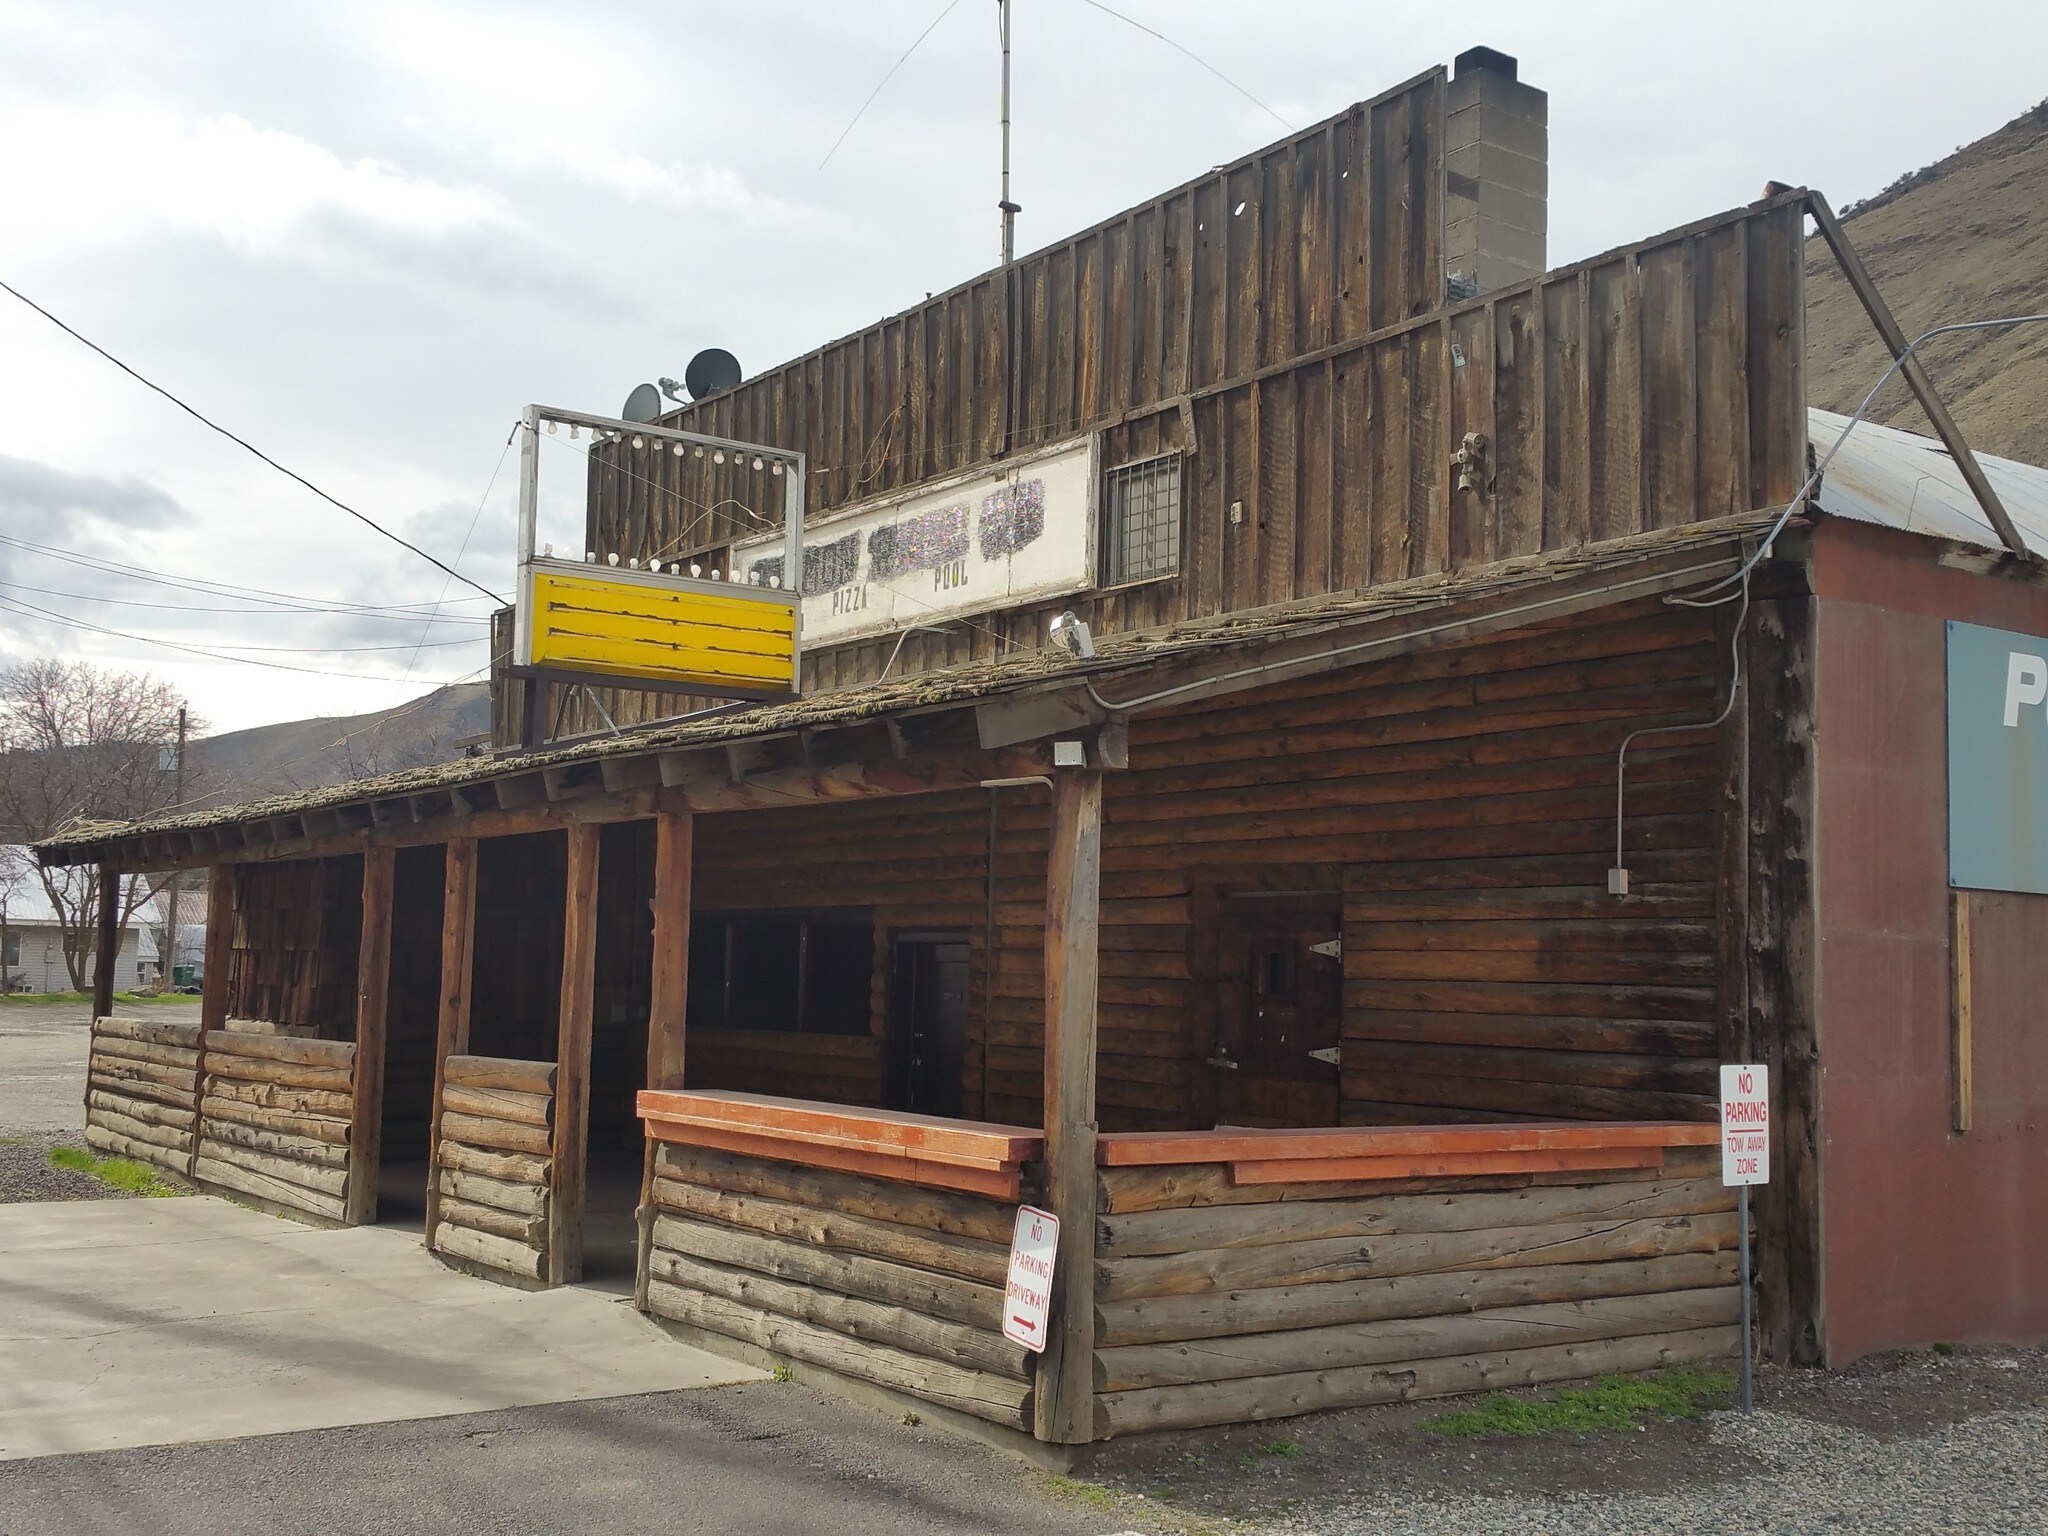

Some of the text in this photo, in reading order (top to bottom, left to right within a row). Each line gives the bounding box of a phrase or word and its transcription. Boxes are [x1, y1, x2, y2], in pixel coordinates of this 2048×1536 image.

[833, 559, 968, 616] PIZZA POOL
[2003, 651, 2048, 728] P
[1737, 1073, 1753, 1095] NO
[1725, 1101, 1767, 1123] PARKING
[1726, 1136, 1766, 1153] TOW AWAY
[1736, 1158, 1757, 1174] ZONE
[1030, 1223, 1043, 1242] NO
[1014, 1250, 1049, 1279] PARKING
[1008, 1281, 1047, 1312] DRIVEWAY
